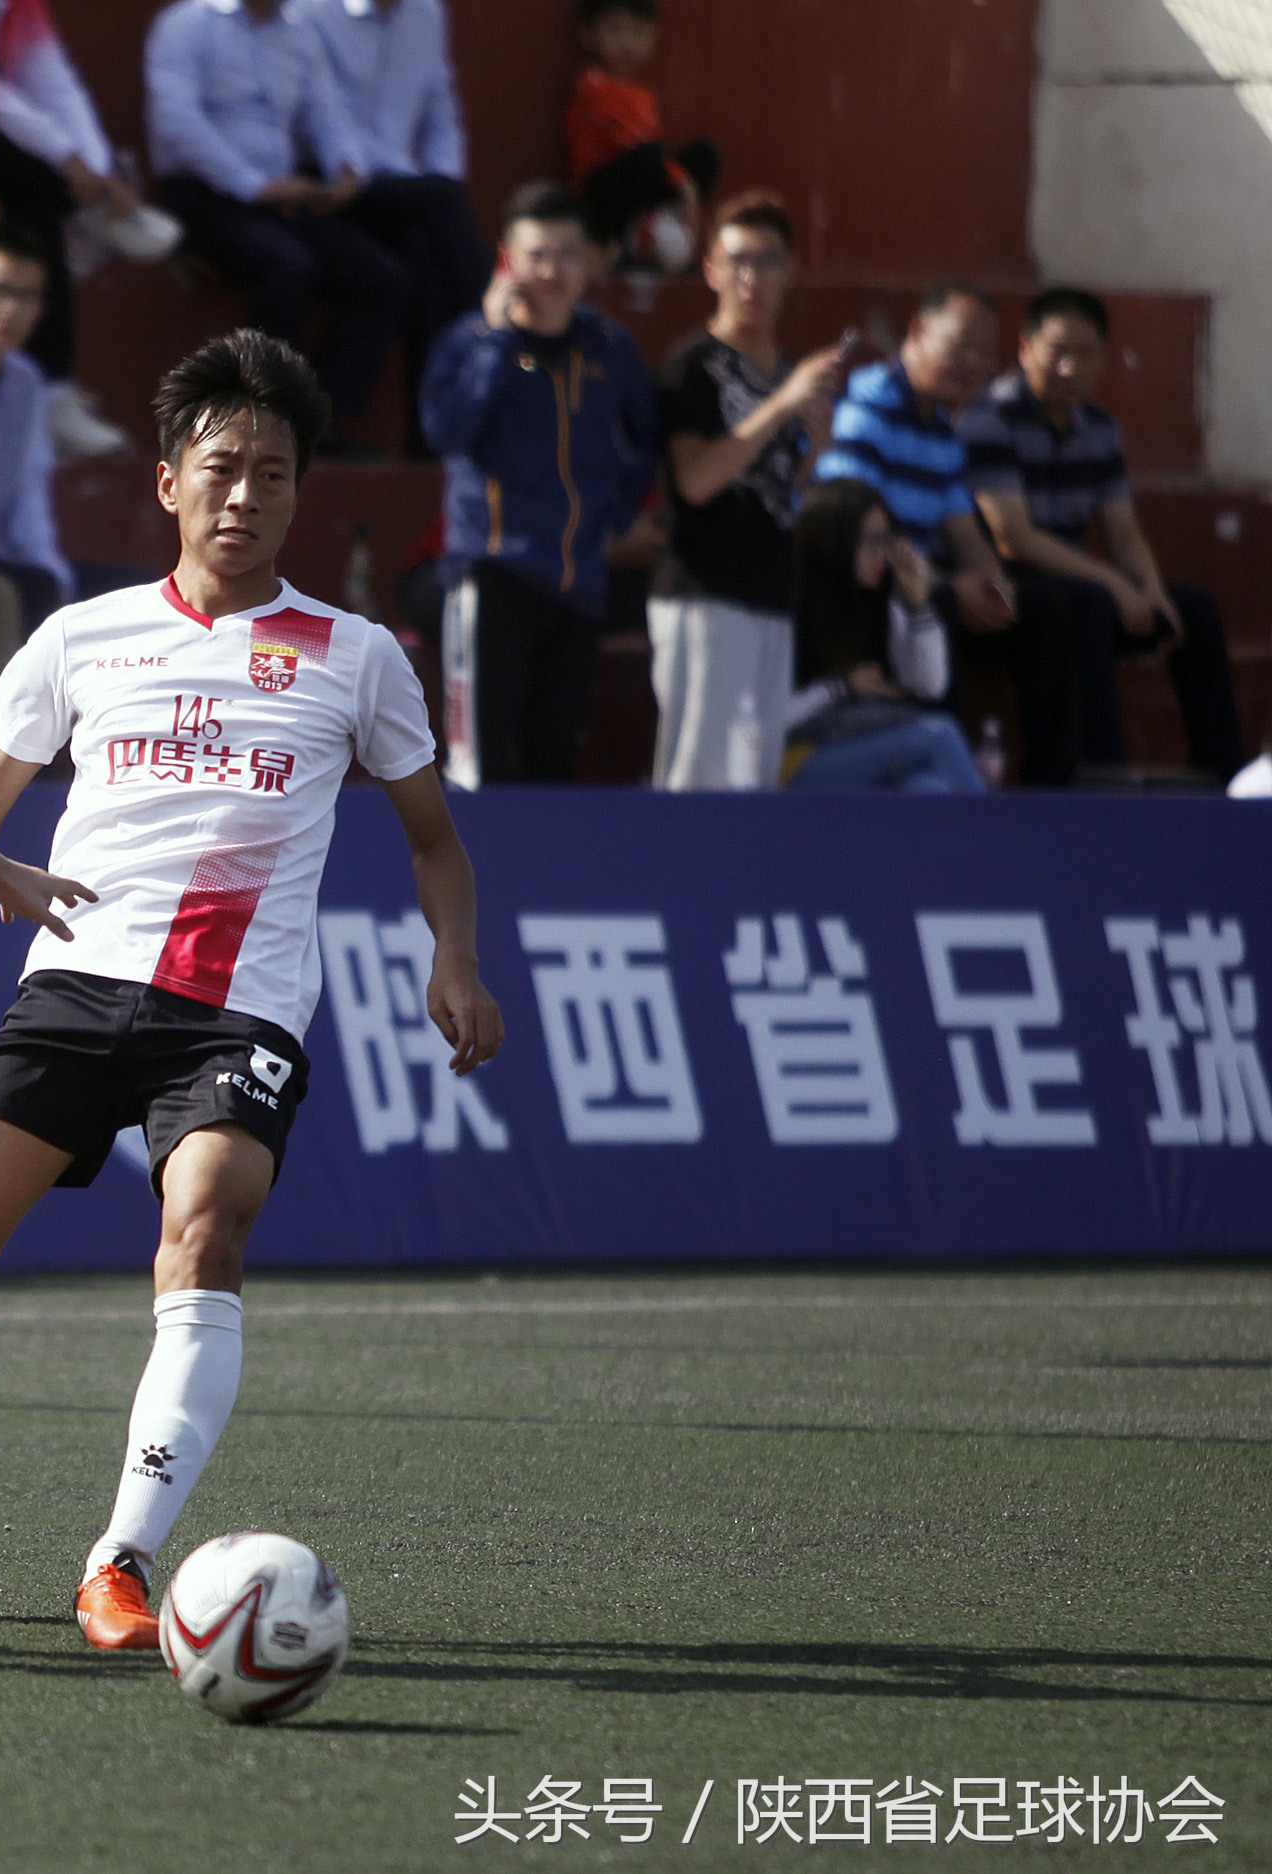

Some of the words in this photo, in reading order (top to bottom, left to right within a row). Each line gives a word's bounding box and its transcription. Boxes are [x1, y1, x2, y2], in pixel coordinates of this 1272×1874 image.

[96, 656, 169, 671] KELME
[172, 694, 223, 740] 145
[216, 1072, 278, 1110] KELME
[131, 1466, 173, 1485] KELME
